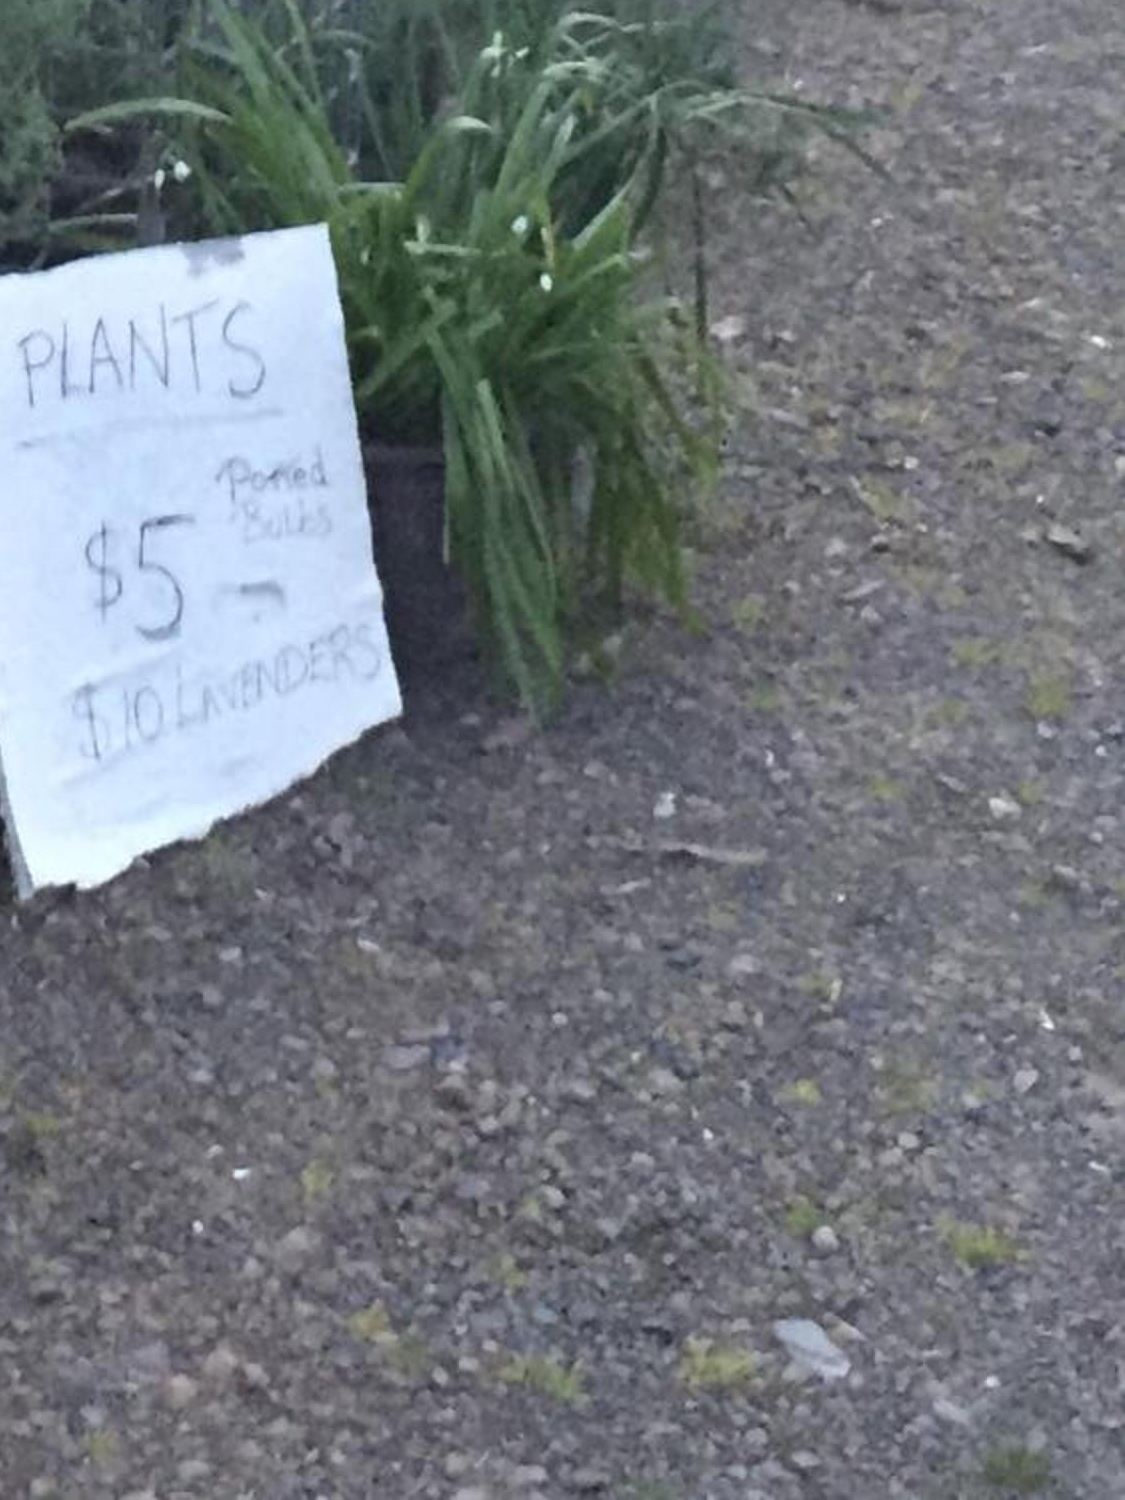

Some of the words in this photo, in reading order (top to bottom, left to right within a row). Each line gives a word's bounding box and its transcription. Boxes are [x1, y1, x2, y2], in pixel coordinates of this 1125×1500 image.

[17, 297, 266, 408] PLANTS
[84, 514, 196, 642] $5
[71, 681, 163, 760] $10
[176, 624, 381, 728] LAVENDERS
